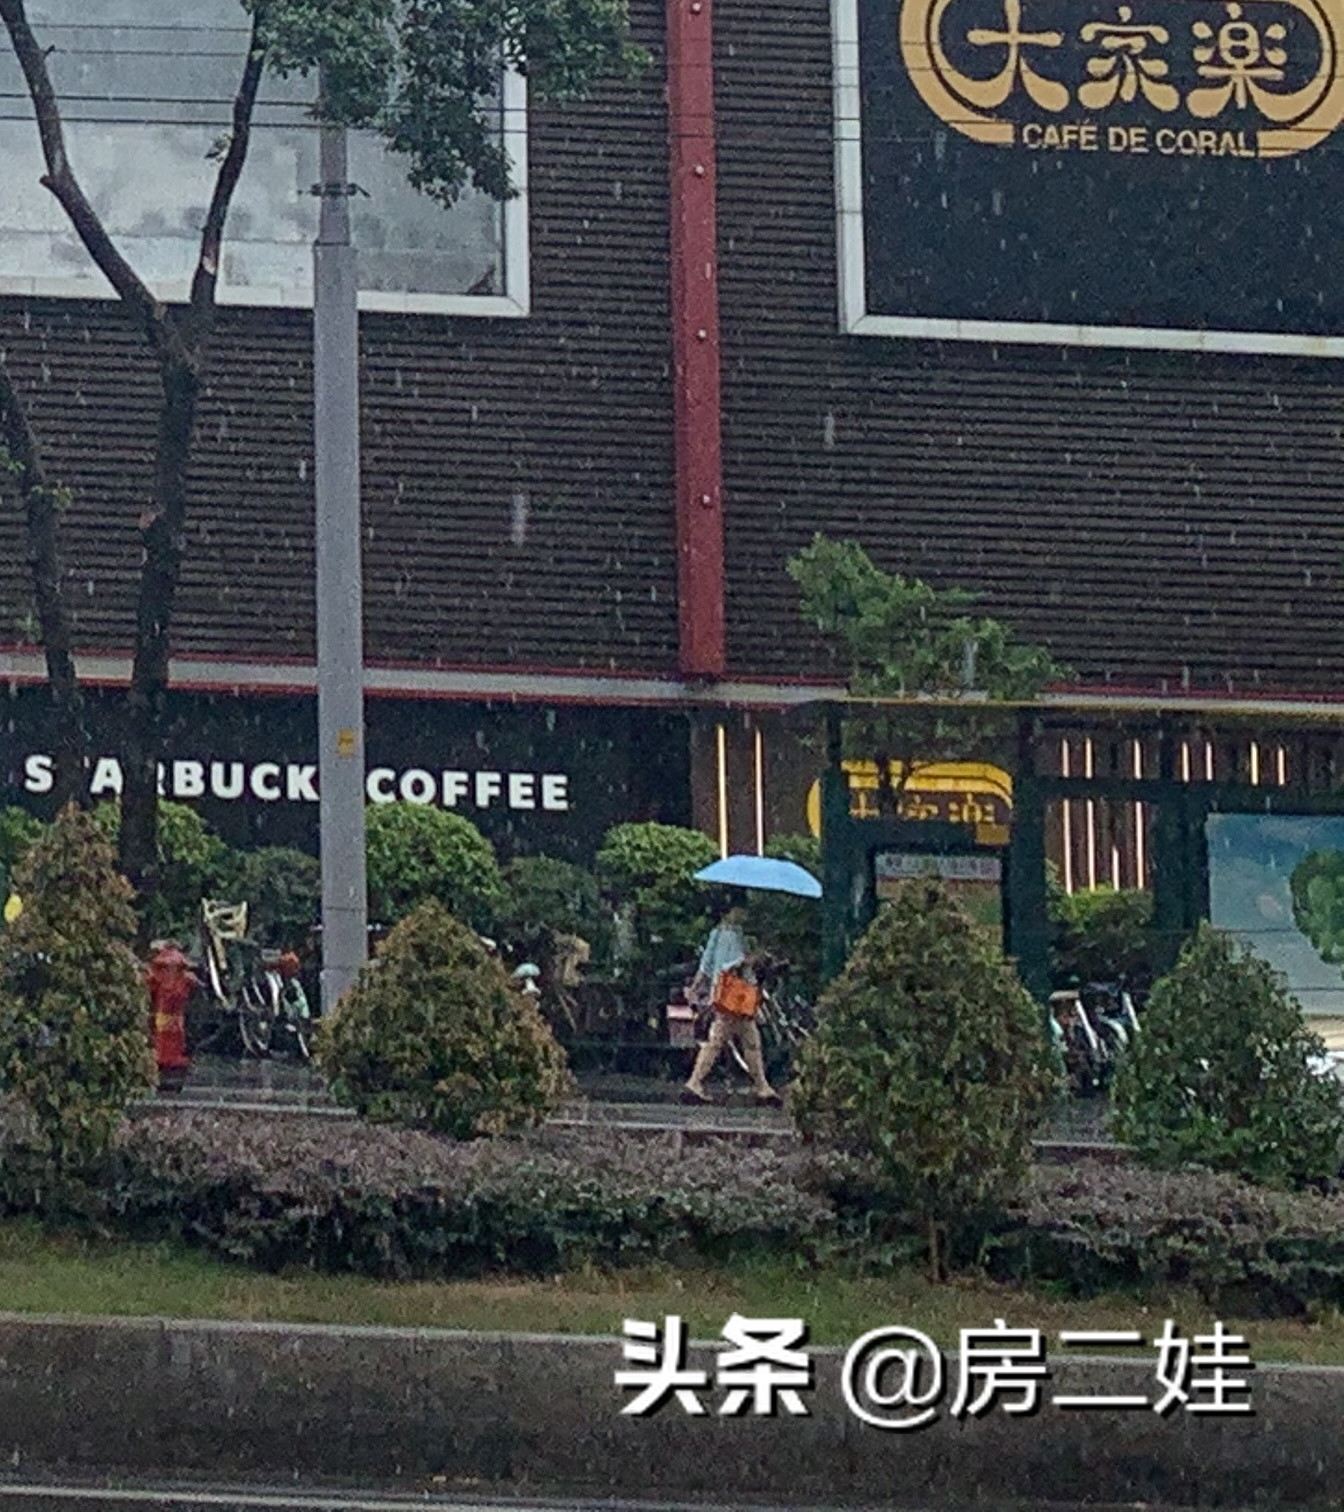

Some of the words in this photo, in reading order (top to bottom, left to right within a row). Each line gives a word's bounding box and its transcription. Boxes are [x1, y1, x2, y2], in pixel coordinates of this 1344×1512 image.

[1108, 126, 1149, 153] DE
[1155, 129, 1256, 158] CORAL
[24, 754, 320, 801] SABUCK
[365, 768, 569, 811] COFFEE
